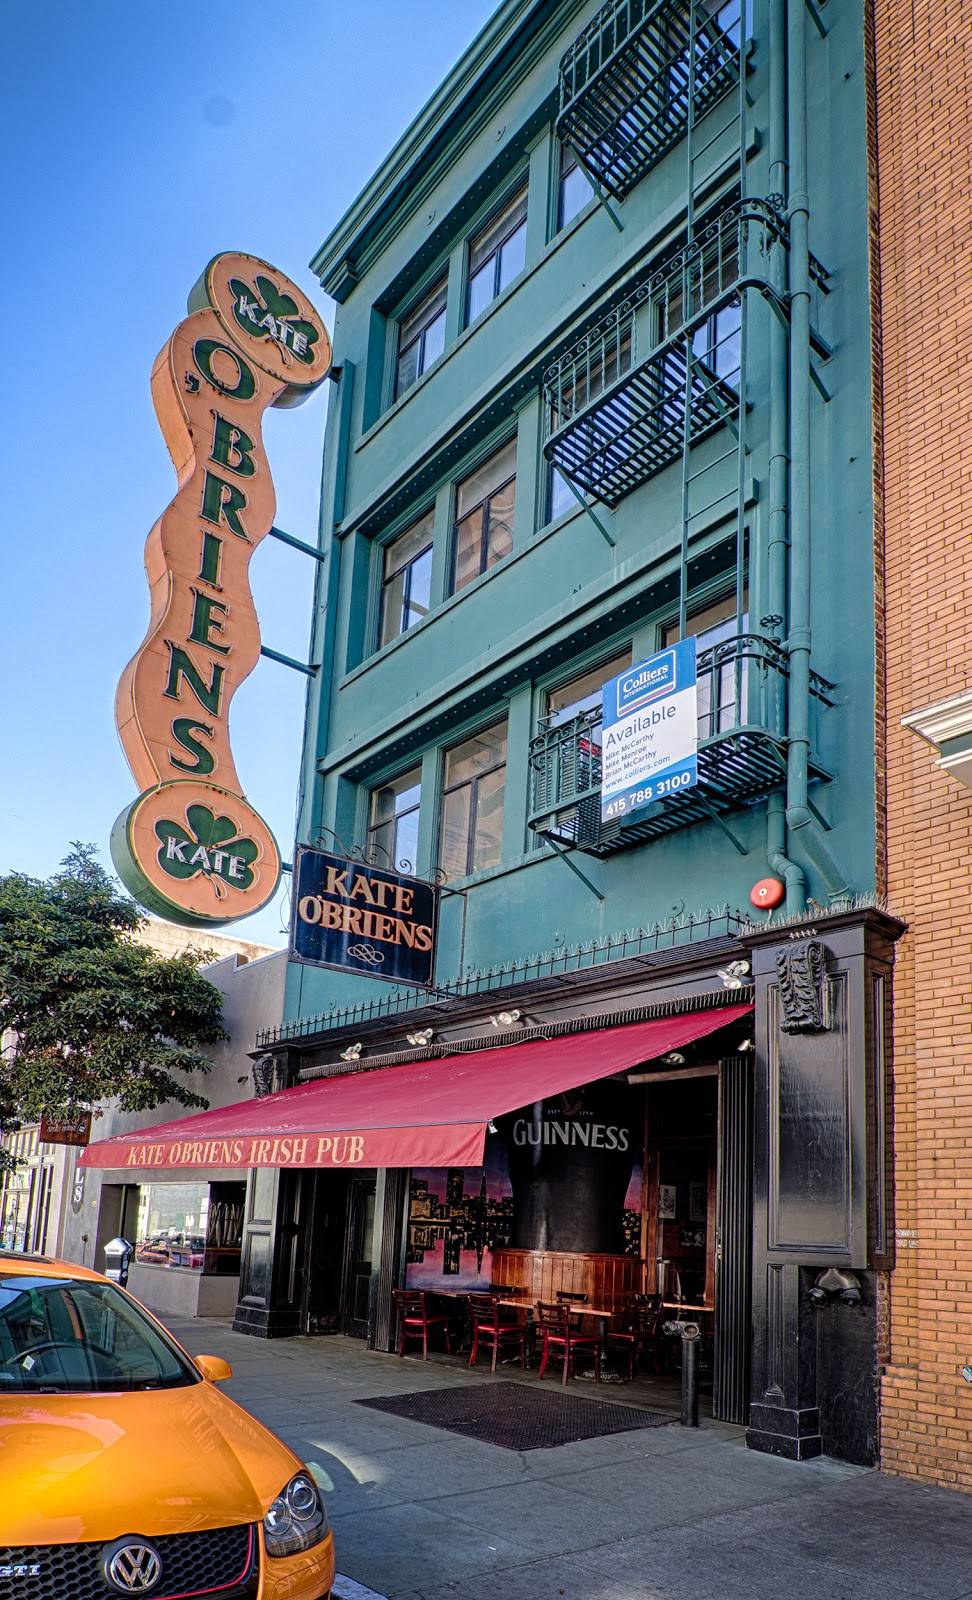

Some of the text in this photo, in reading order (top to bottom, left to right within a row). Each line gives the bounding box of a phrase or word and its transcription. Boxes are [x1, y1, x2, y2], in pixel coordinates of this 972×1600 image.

[238, 295, 310, 355] KATE
[622, 663, 669, 694] Colliers
[623, 674, 669, 700] INTERNATIONAL
[605, 704, 677, 750] Available
[605, 732, 655, 762] Mike McCarthy
[605, 745, 647, 771] Mike Monroe
[605, 750, 657, 780] Brian McCarthy
[605, 754, 671, 790] www.colliers.com
[606, 771, 691, 816] 415 788 3100
[166, 836, 247, 879] KATE
[323, 865, 415, 916] KATE
[298, 894, 433, 952] O'BRIENS
[126, 1135, 366, 1166] KATE O'BRIENS IRISH PUB
[512, 1118, 630, 1152] GUINNESS
[0, 1564, 40, 1577] GTI
